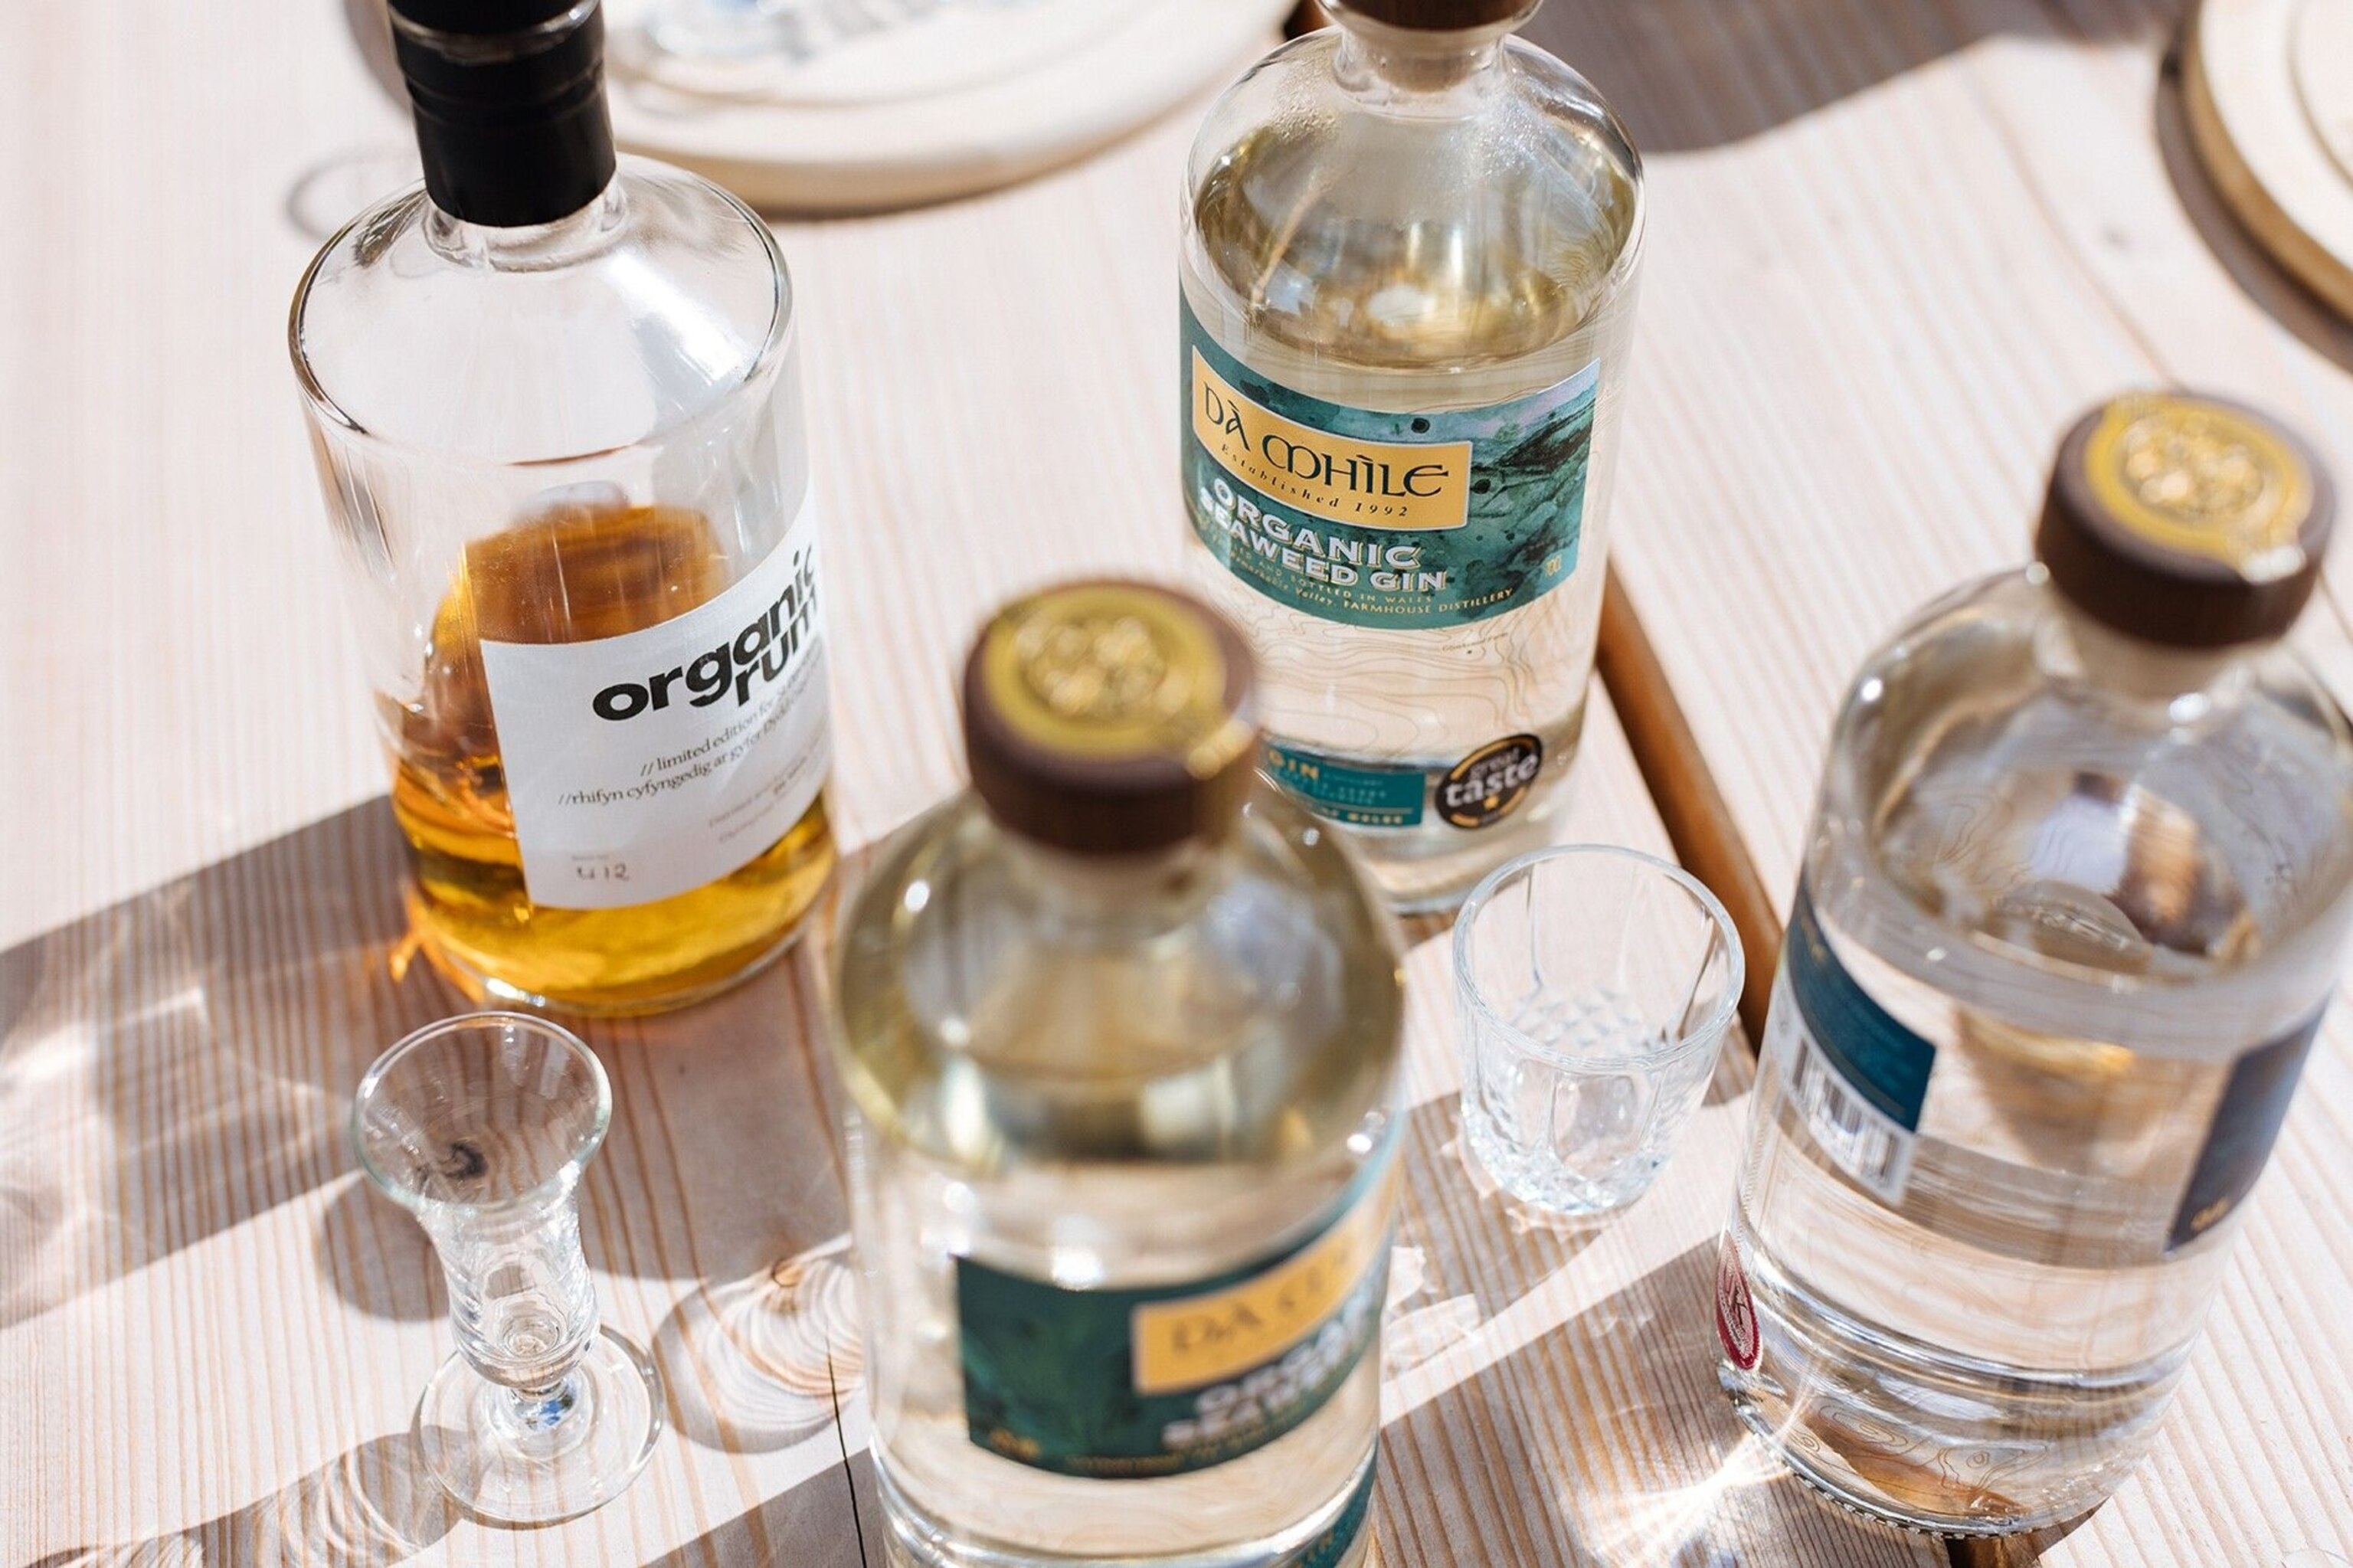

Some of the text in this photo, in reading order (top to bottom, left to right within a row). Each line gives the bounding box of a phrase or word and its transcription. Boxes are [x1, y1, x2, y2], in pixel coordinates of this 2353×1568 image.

[1222, 444, 1409, 517] Established 1992
[1199, 486, 1447, 593] SEAWEED GIN
[1213, 478, 1422, 569] ORGANIC
[592, 543, 815, 722] organic
[1343, 600, 1432, 614] FARMHOUSE
[1438, 588, 1514, 611] DISTILLERY
[656, 738, 710, 771] limited
[1445, 754, 1540, 808] taste
